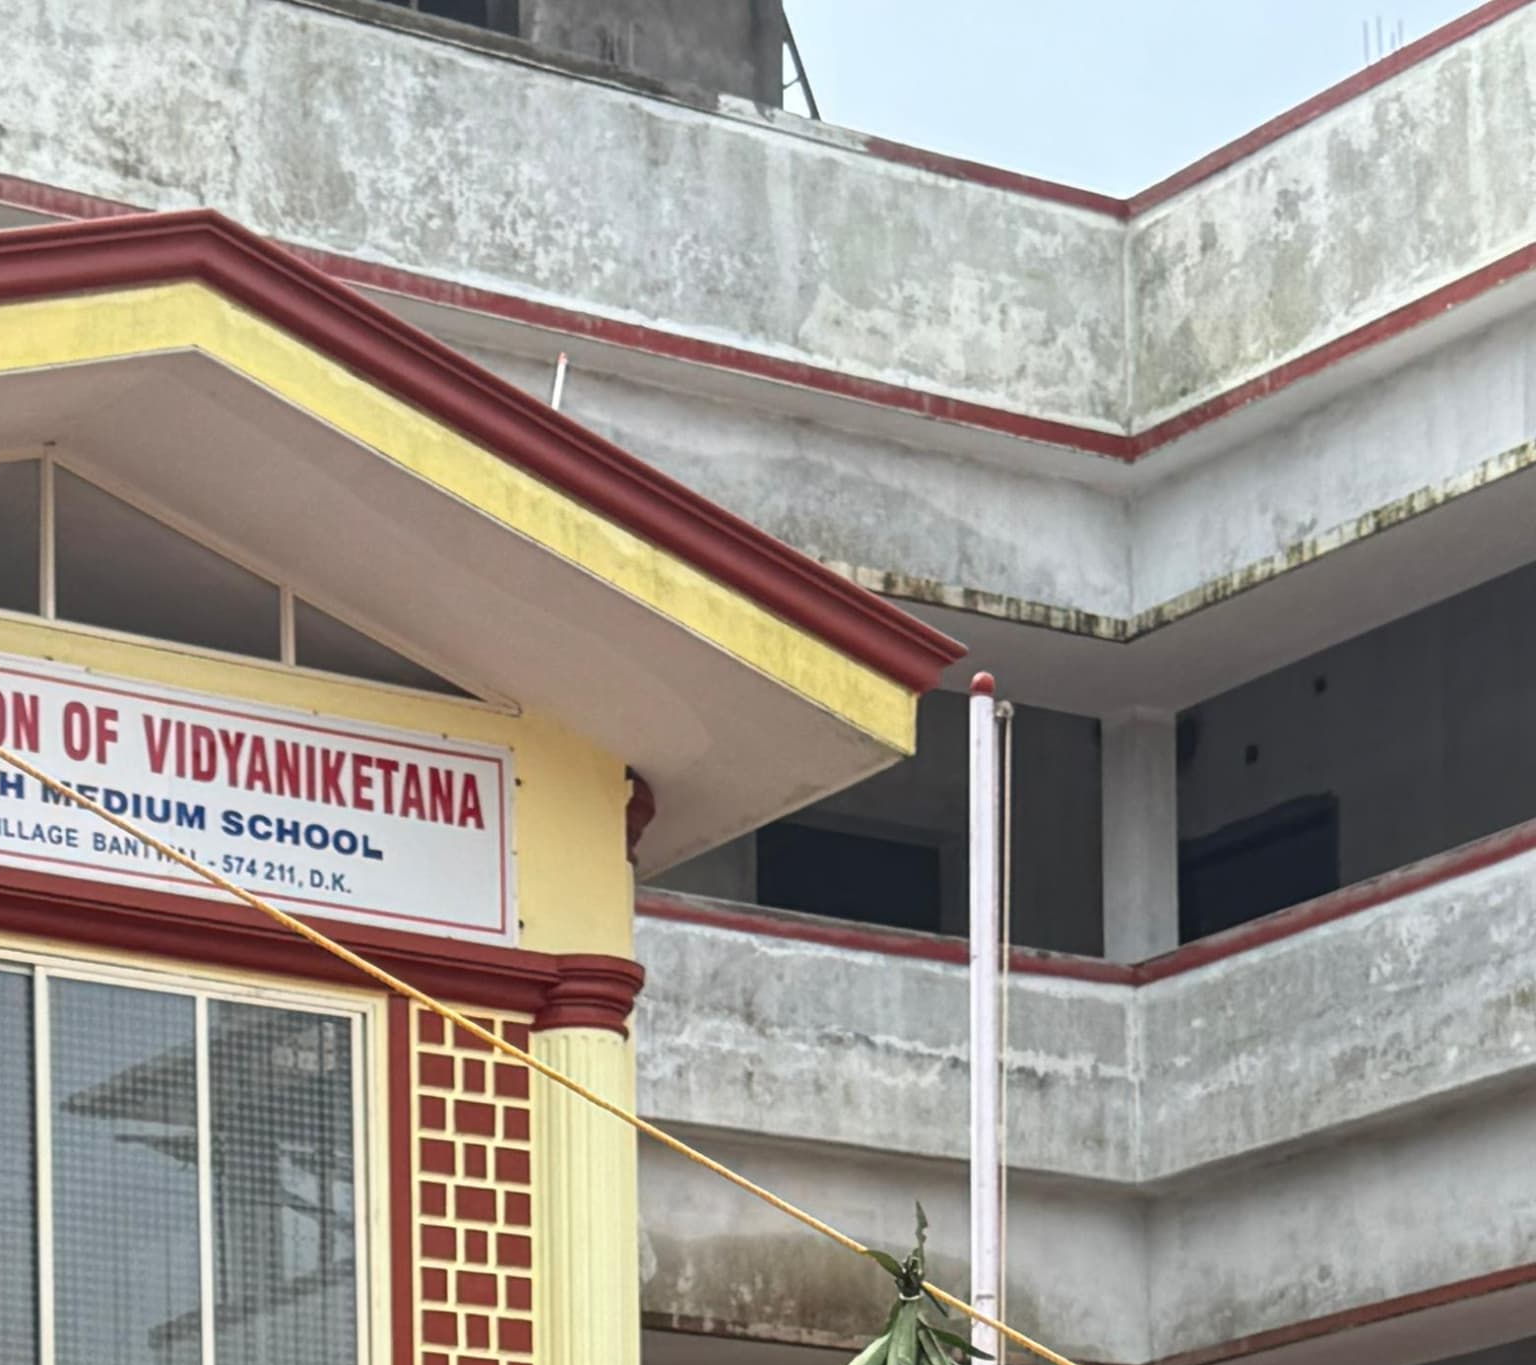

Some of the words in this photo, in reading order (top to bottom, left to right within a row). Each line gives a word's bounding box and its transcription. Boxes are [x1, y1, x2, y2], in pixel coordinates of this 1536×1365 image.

[63, 700, 119, 765] OF
[141, 713, 486, 830] VIDYANIKETANA
[220, 809, 383, 861] SCHOOL
[221, 854, 258, 878] 574
[264, 861, 304, 888] 211,
[309, 869, 353, 894] D.K.
